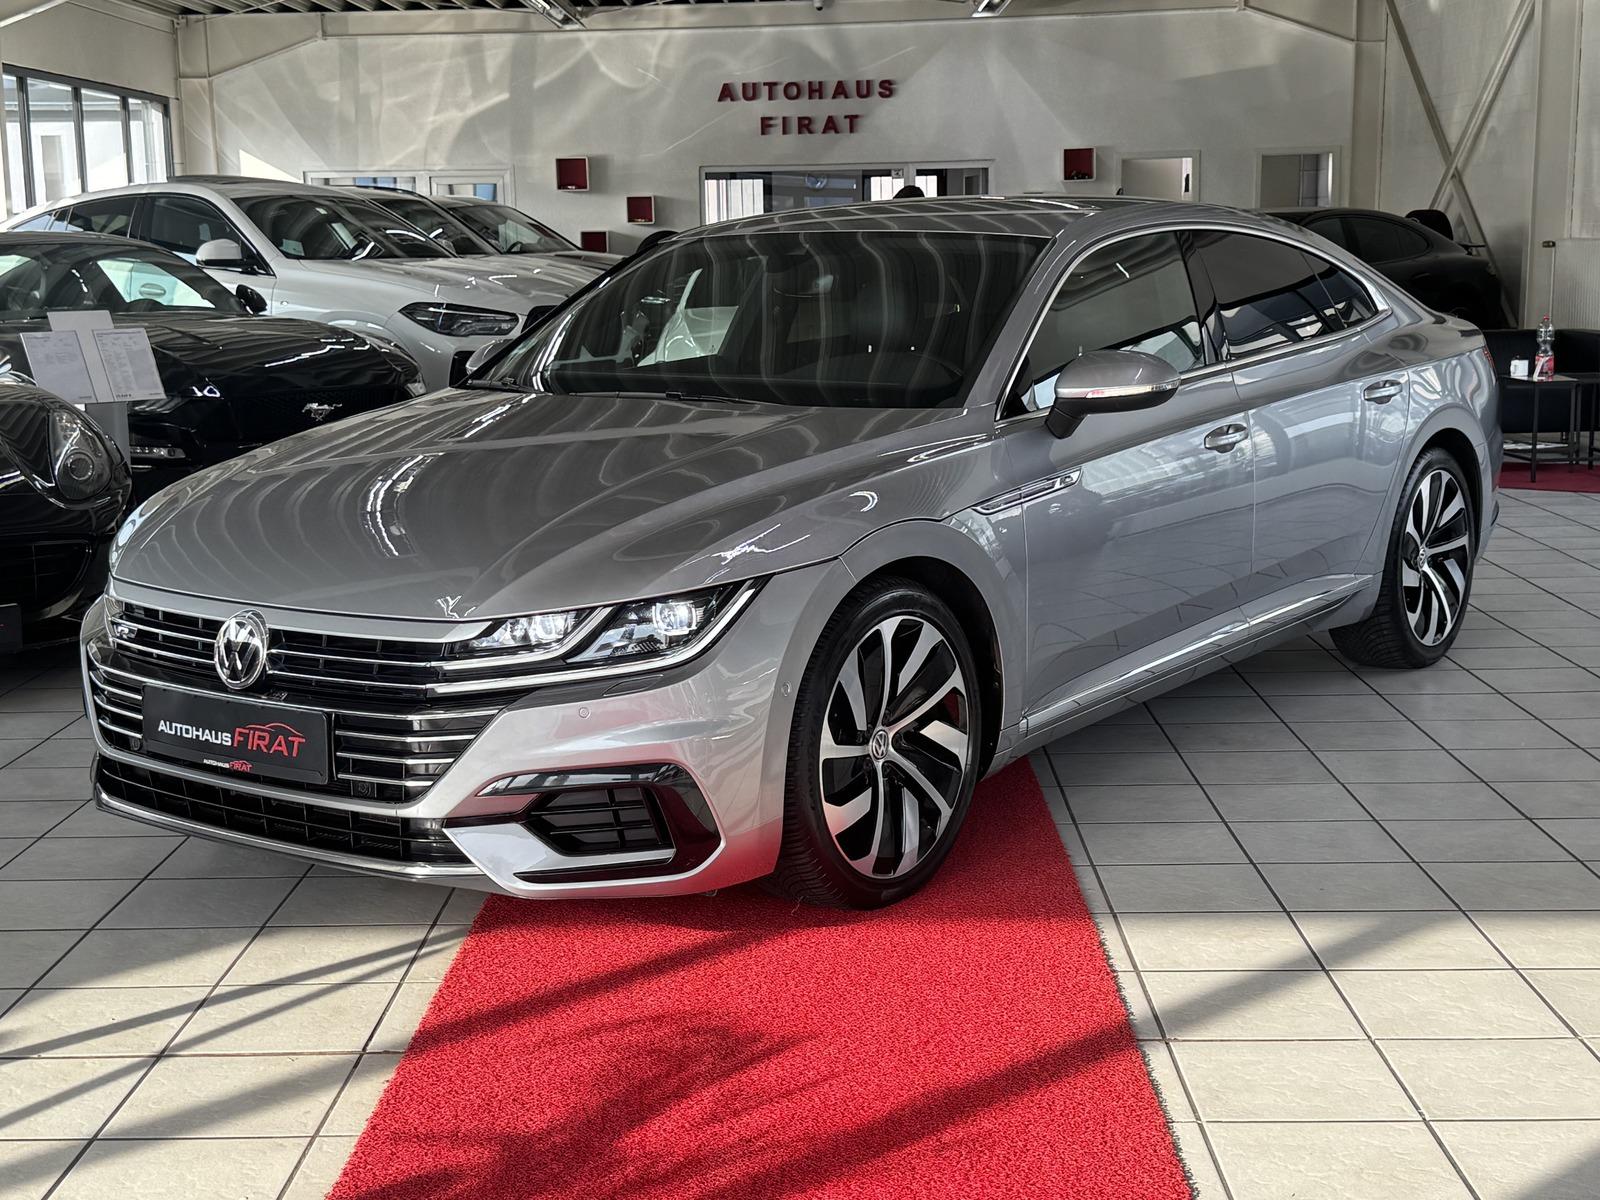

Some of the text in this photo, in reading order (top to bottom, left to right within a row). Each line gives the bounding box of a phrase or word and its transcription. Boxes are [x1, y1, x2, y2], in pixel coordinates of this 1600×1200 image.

[718, 79, 897, 102] AUTOHAUS
[760, 114, 862, 136] FIRAT
[157, 719, 306, 758] AUTOHAUS FIRAT
[229, 760, 252, 772] FIRAT
